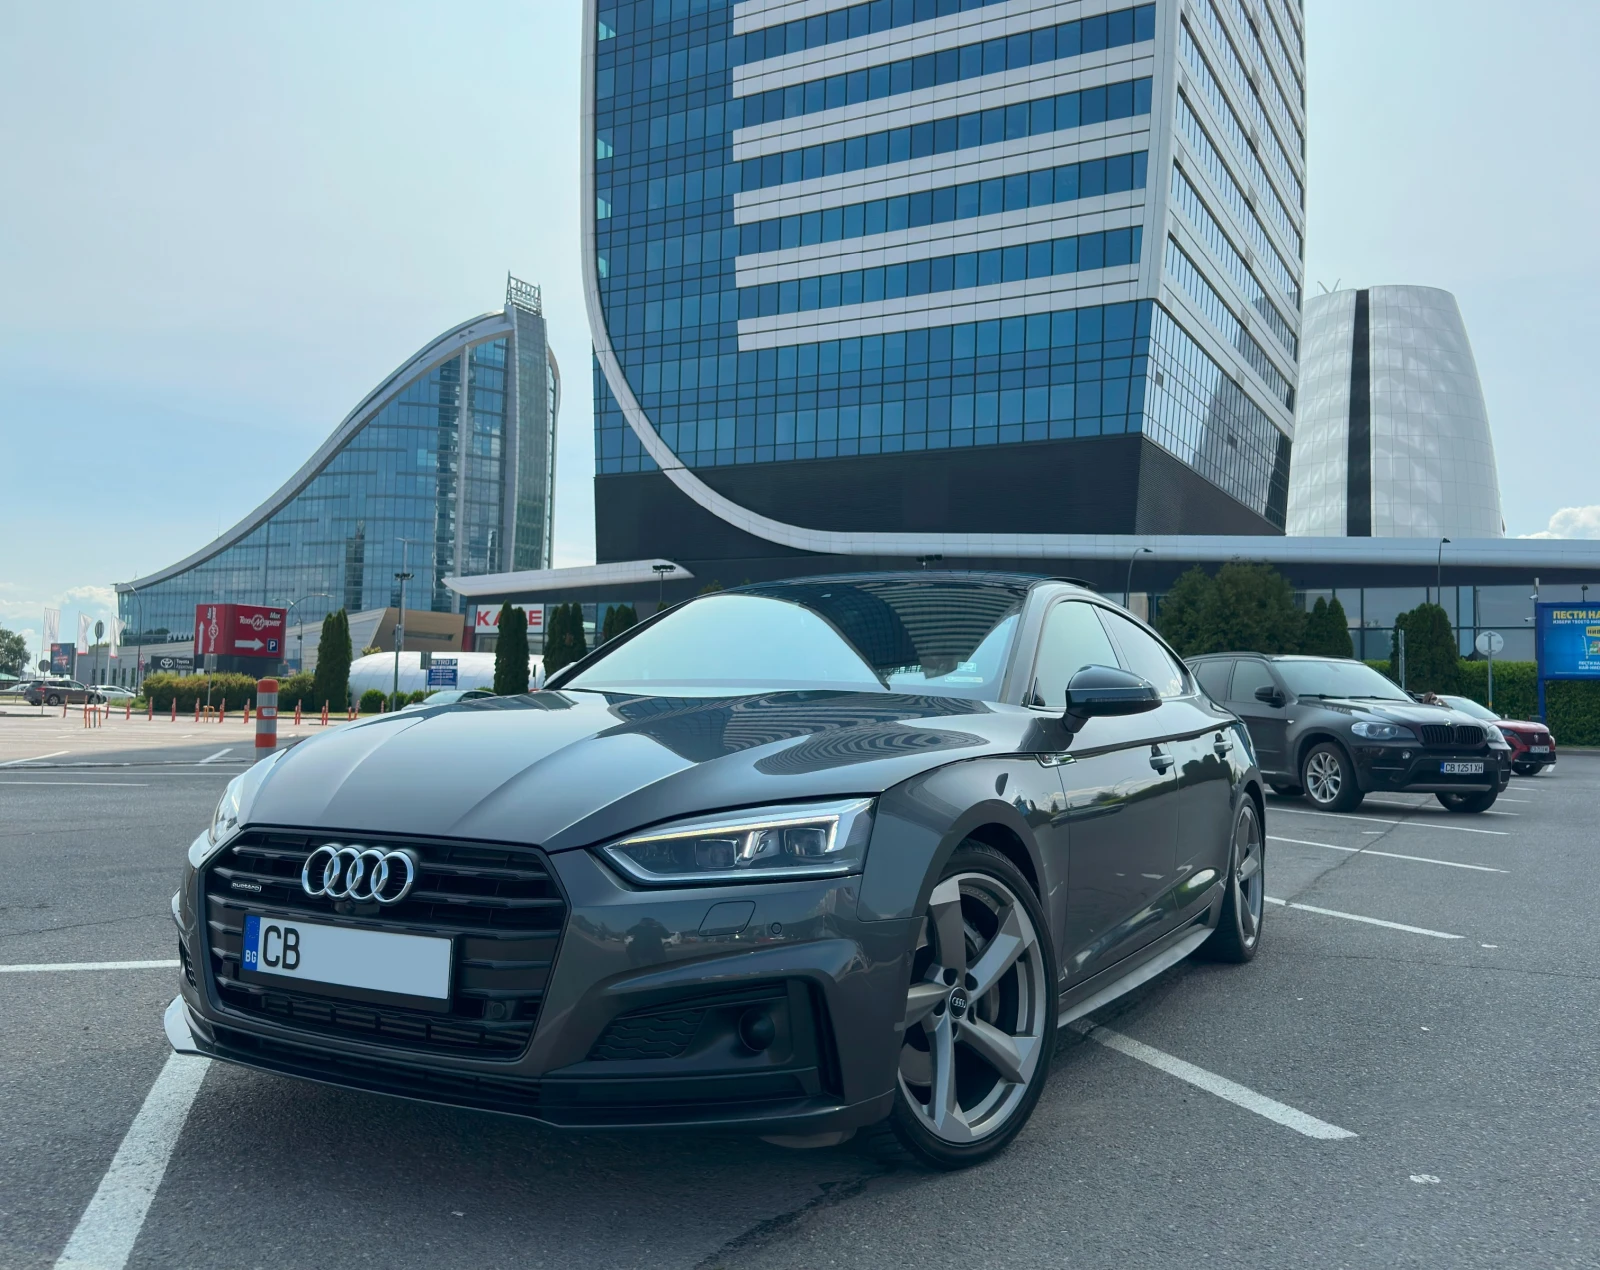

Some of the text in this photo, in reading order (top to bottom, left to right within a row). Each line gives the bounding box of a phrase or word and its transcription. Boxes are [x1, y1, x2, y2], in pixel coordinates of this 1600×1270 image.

[477, 610, 542, 626] KE
[1553, 610, 1586, 619] ПЕСТИ
[269, 641, 276, 650] P
[1457, 764, 1474, 772] 1251
[263, 925, 300, 970] CB
[245, 950, 257, 963] BG
